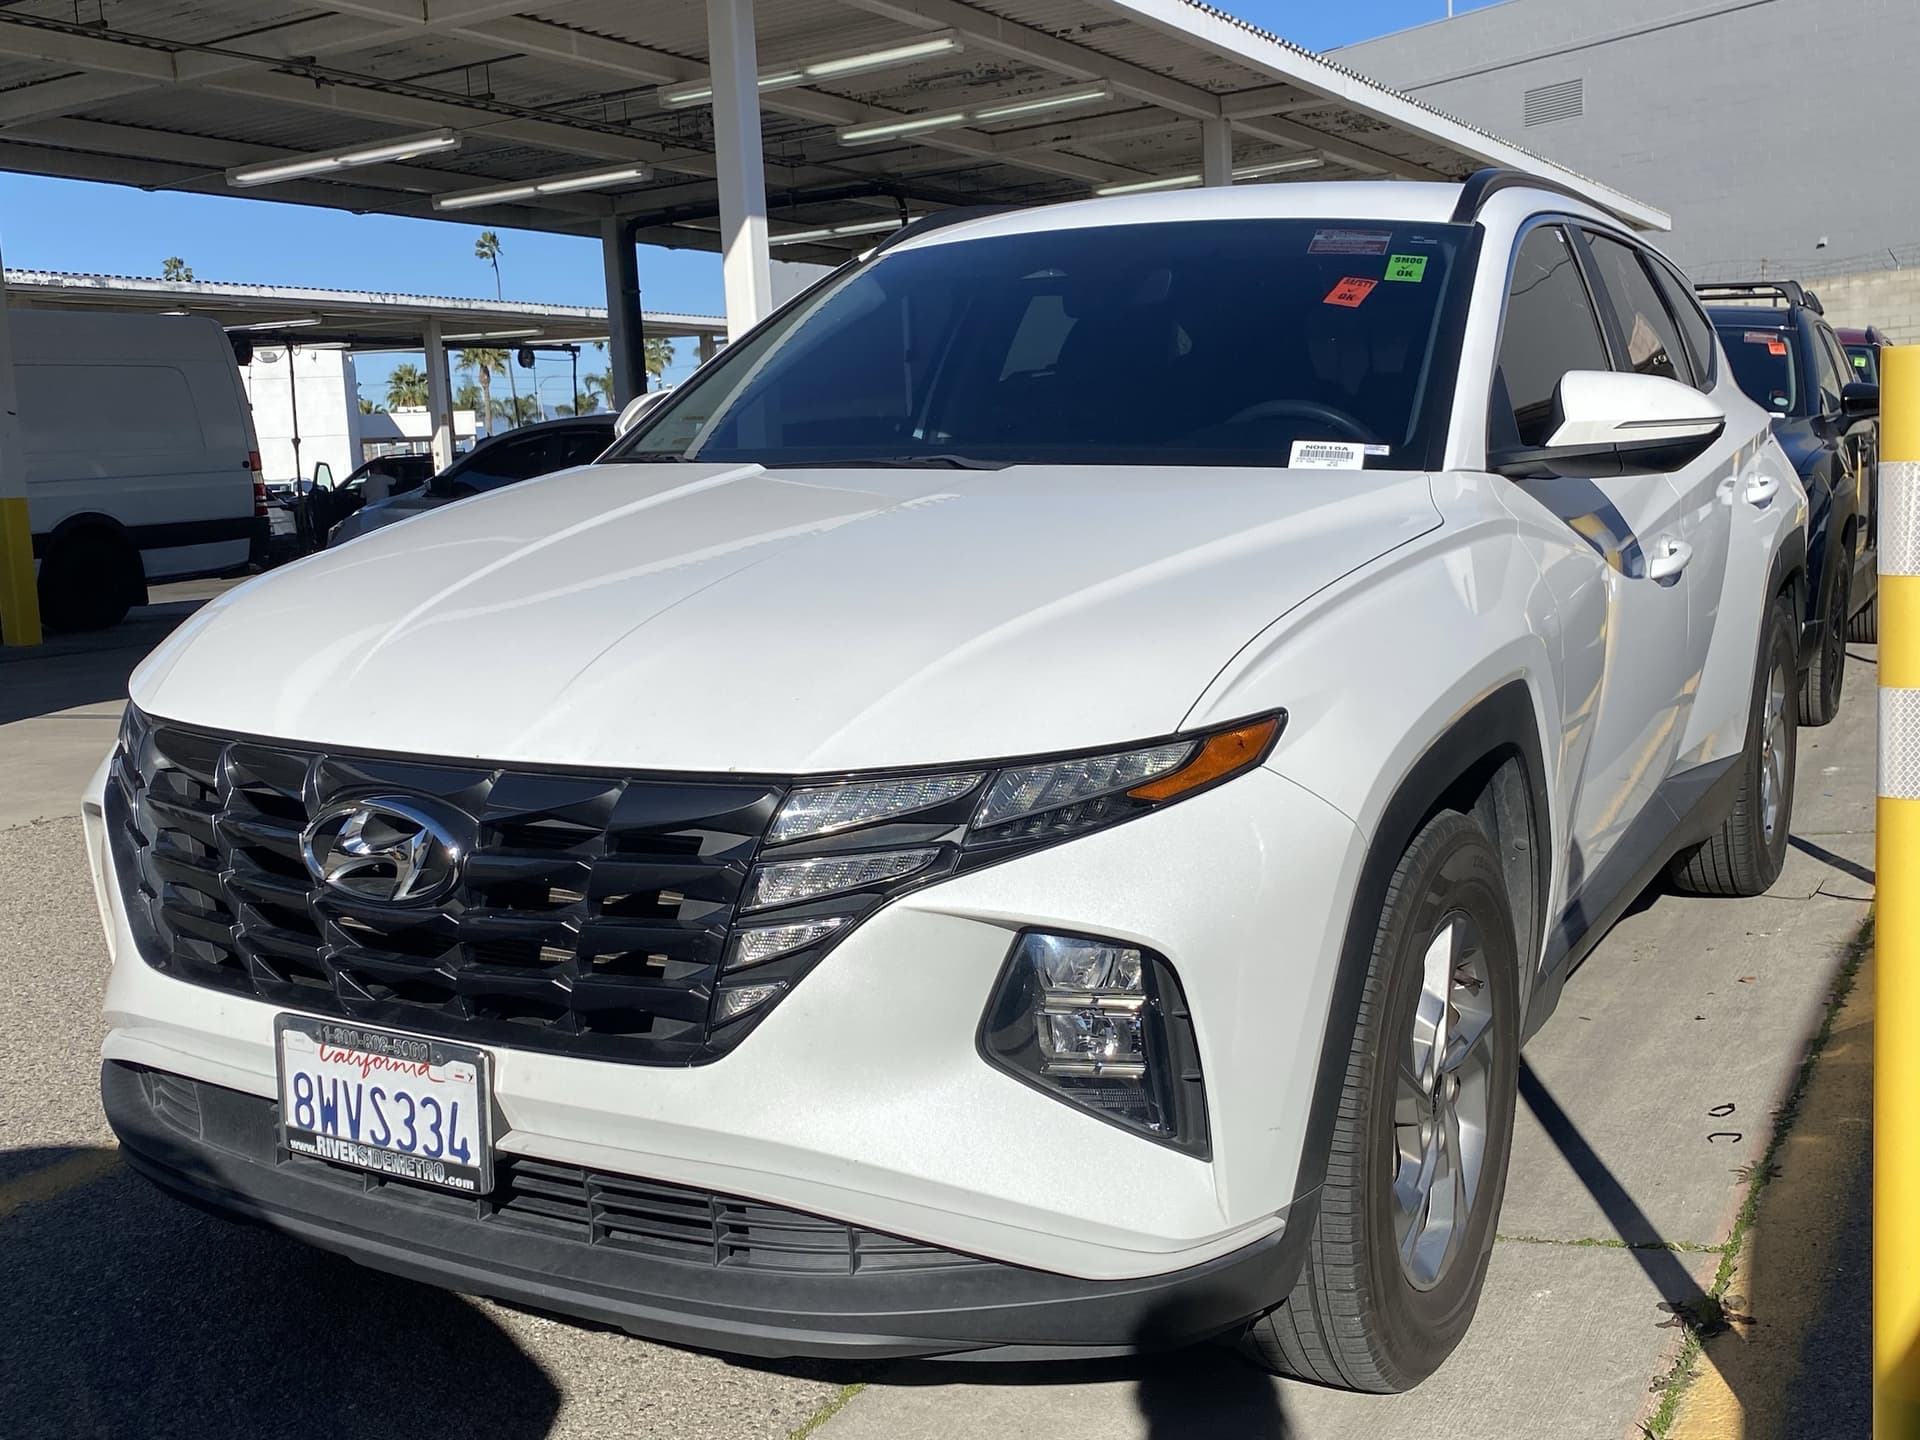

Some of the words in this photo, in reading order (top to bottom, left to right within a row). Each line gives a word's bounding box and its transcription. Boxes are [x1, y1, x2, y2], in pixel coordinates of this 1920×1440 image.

[1394, 256, 1423, 264] SMOG
[1337, 293, 1355, 301] OK
[319, 1043, 445, 1083] California
[293, 1072, 470, 1165] 8WVS334
[290, 1135, 474, 1190] www.RIVERSIDEMETRO.com
